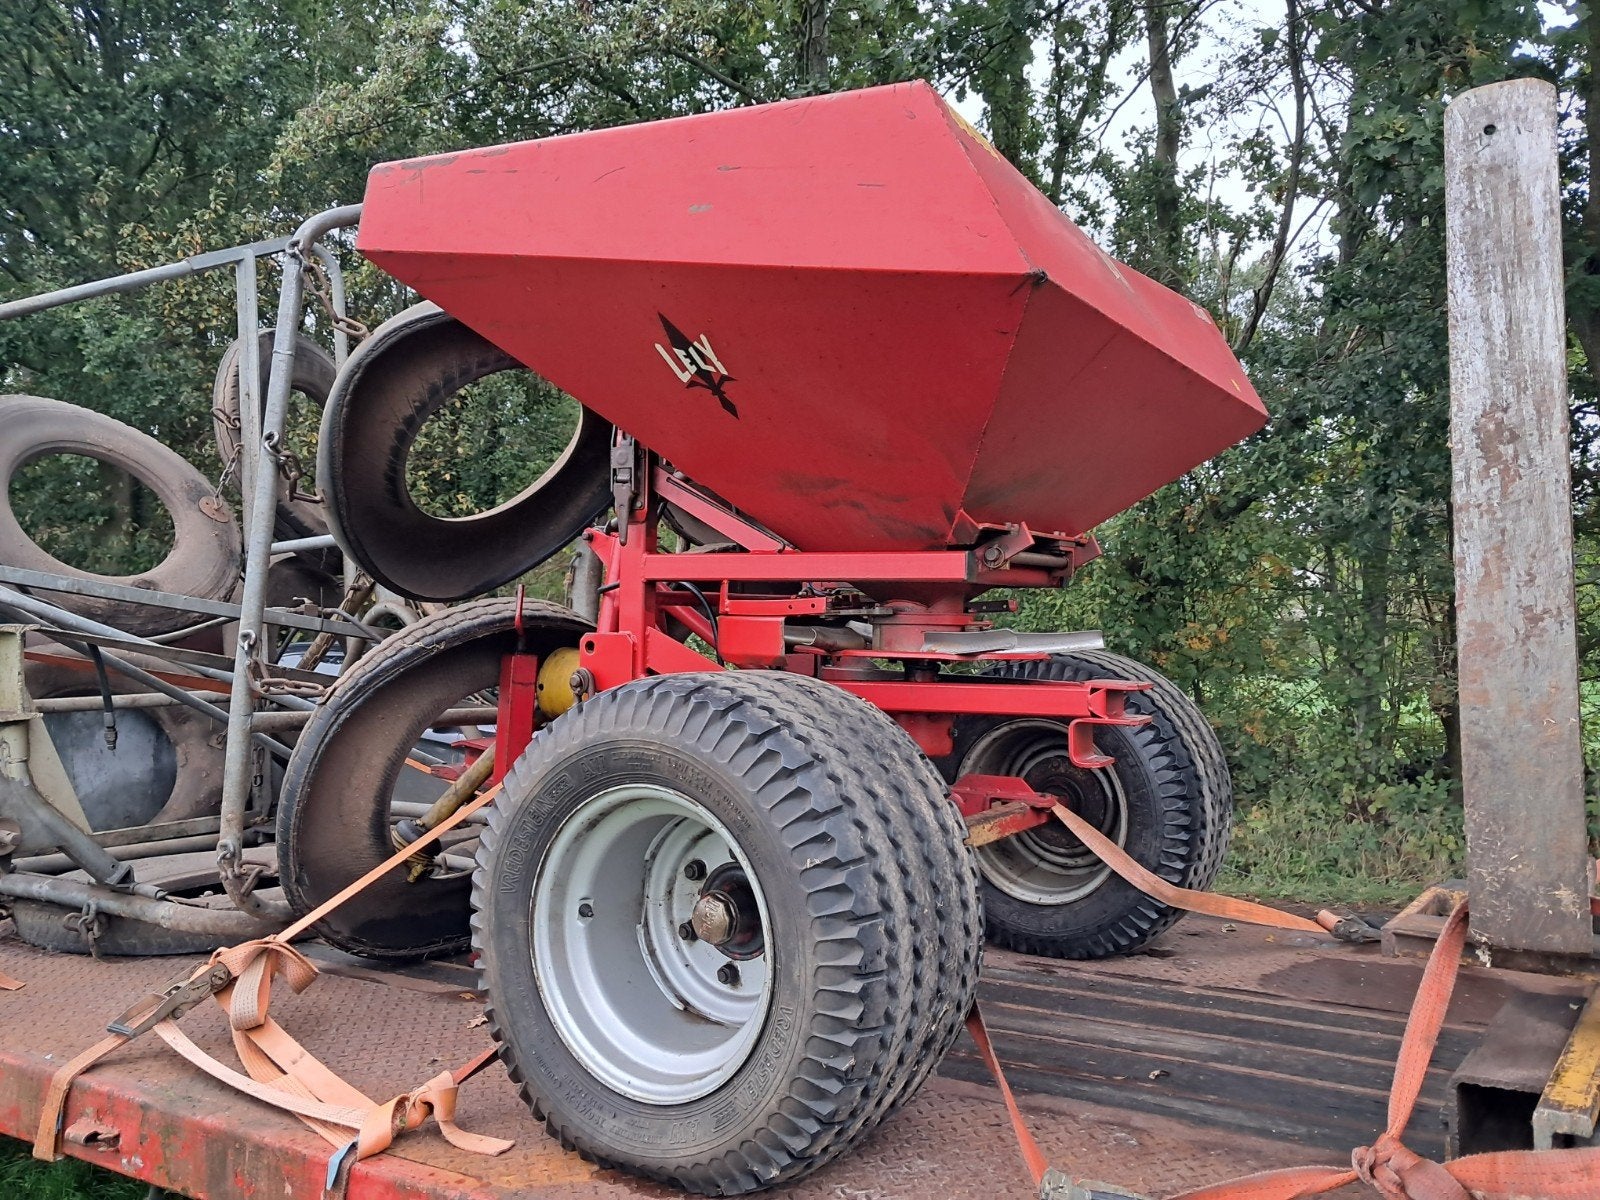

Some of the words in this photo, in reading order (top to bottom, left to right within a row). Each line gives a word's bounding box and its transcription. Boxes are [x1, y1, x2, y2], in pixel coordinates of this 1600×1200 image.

[654, 333, 728, 383] LELY
[500, 796, 556, 894] VREDESTEIN
[733, 1005, 795, 1111] VREDESTEIN
